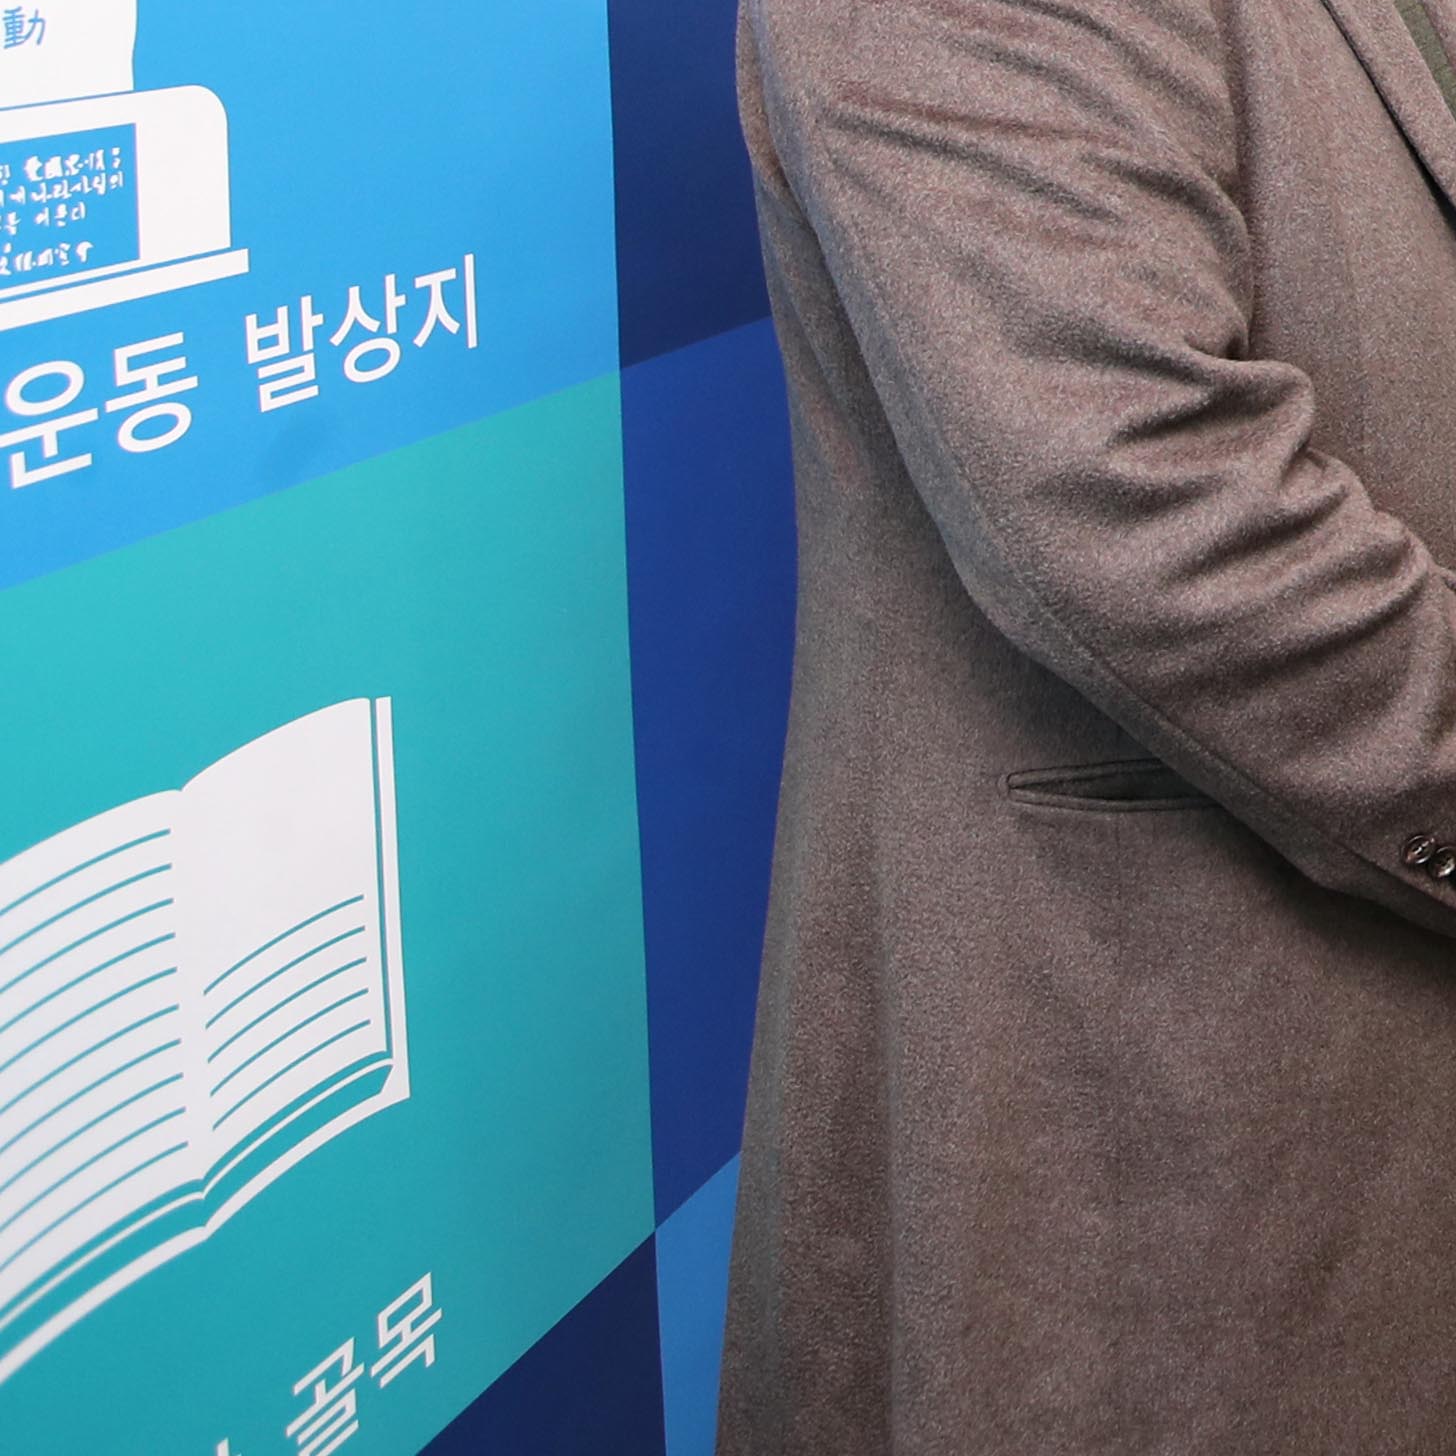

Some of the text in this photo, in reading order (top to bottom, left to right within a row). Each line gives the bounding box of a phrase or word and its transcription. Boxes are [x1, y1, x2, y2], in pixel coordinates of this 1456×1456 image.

[0, 252, 479, 490] 운동 발상지
[286, 1271, 443, 1456] 골목
